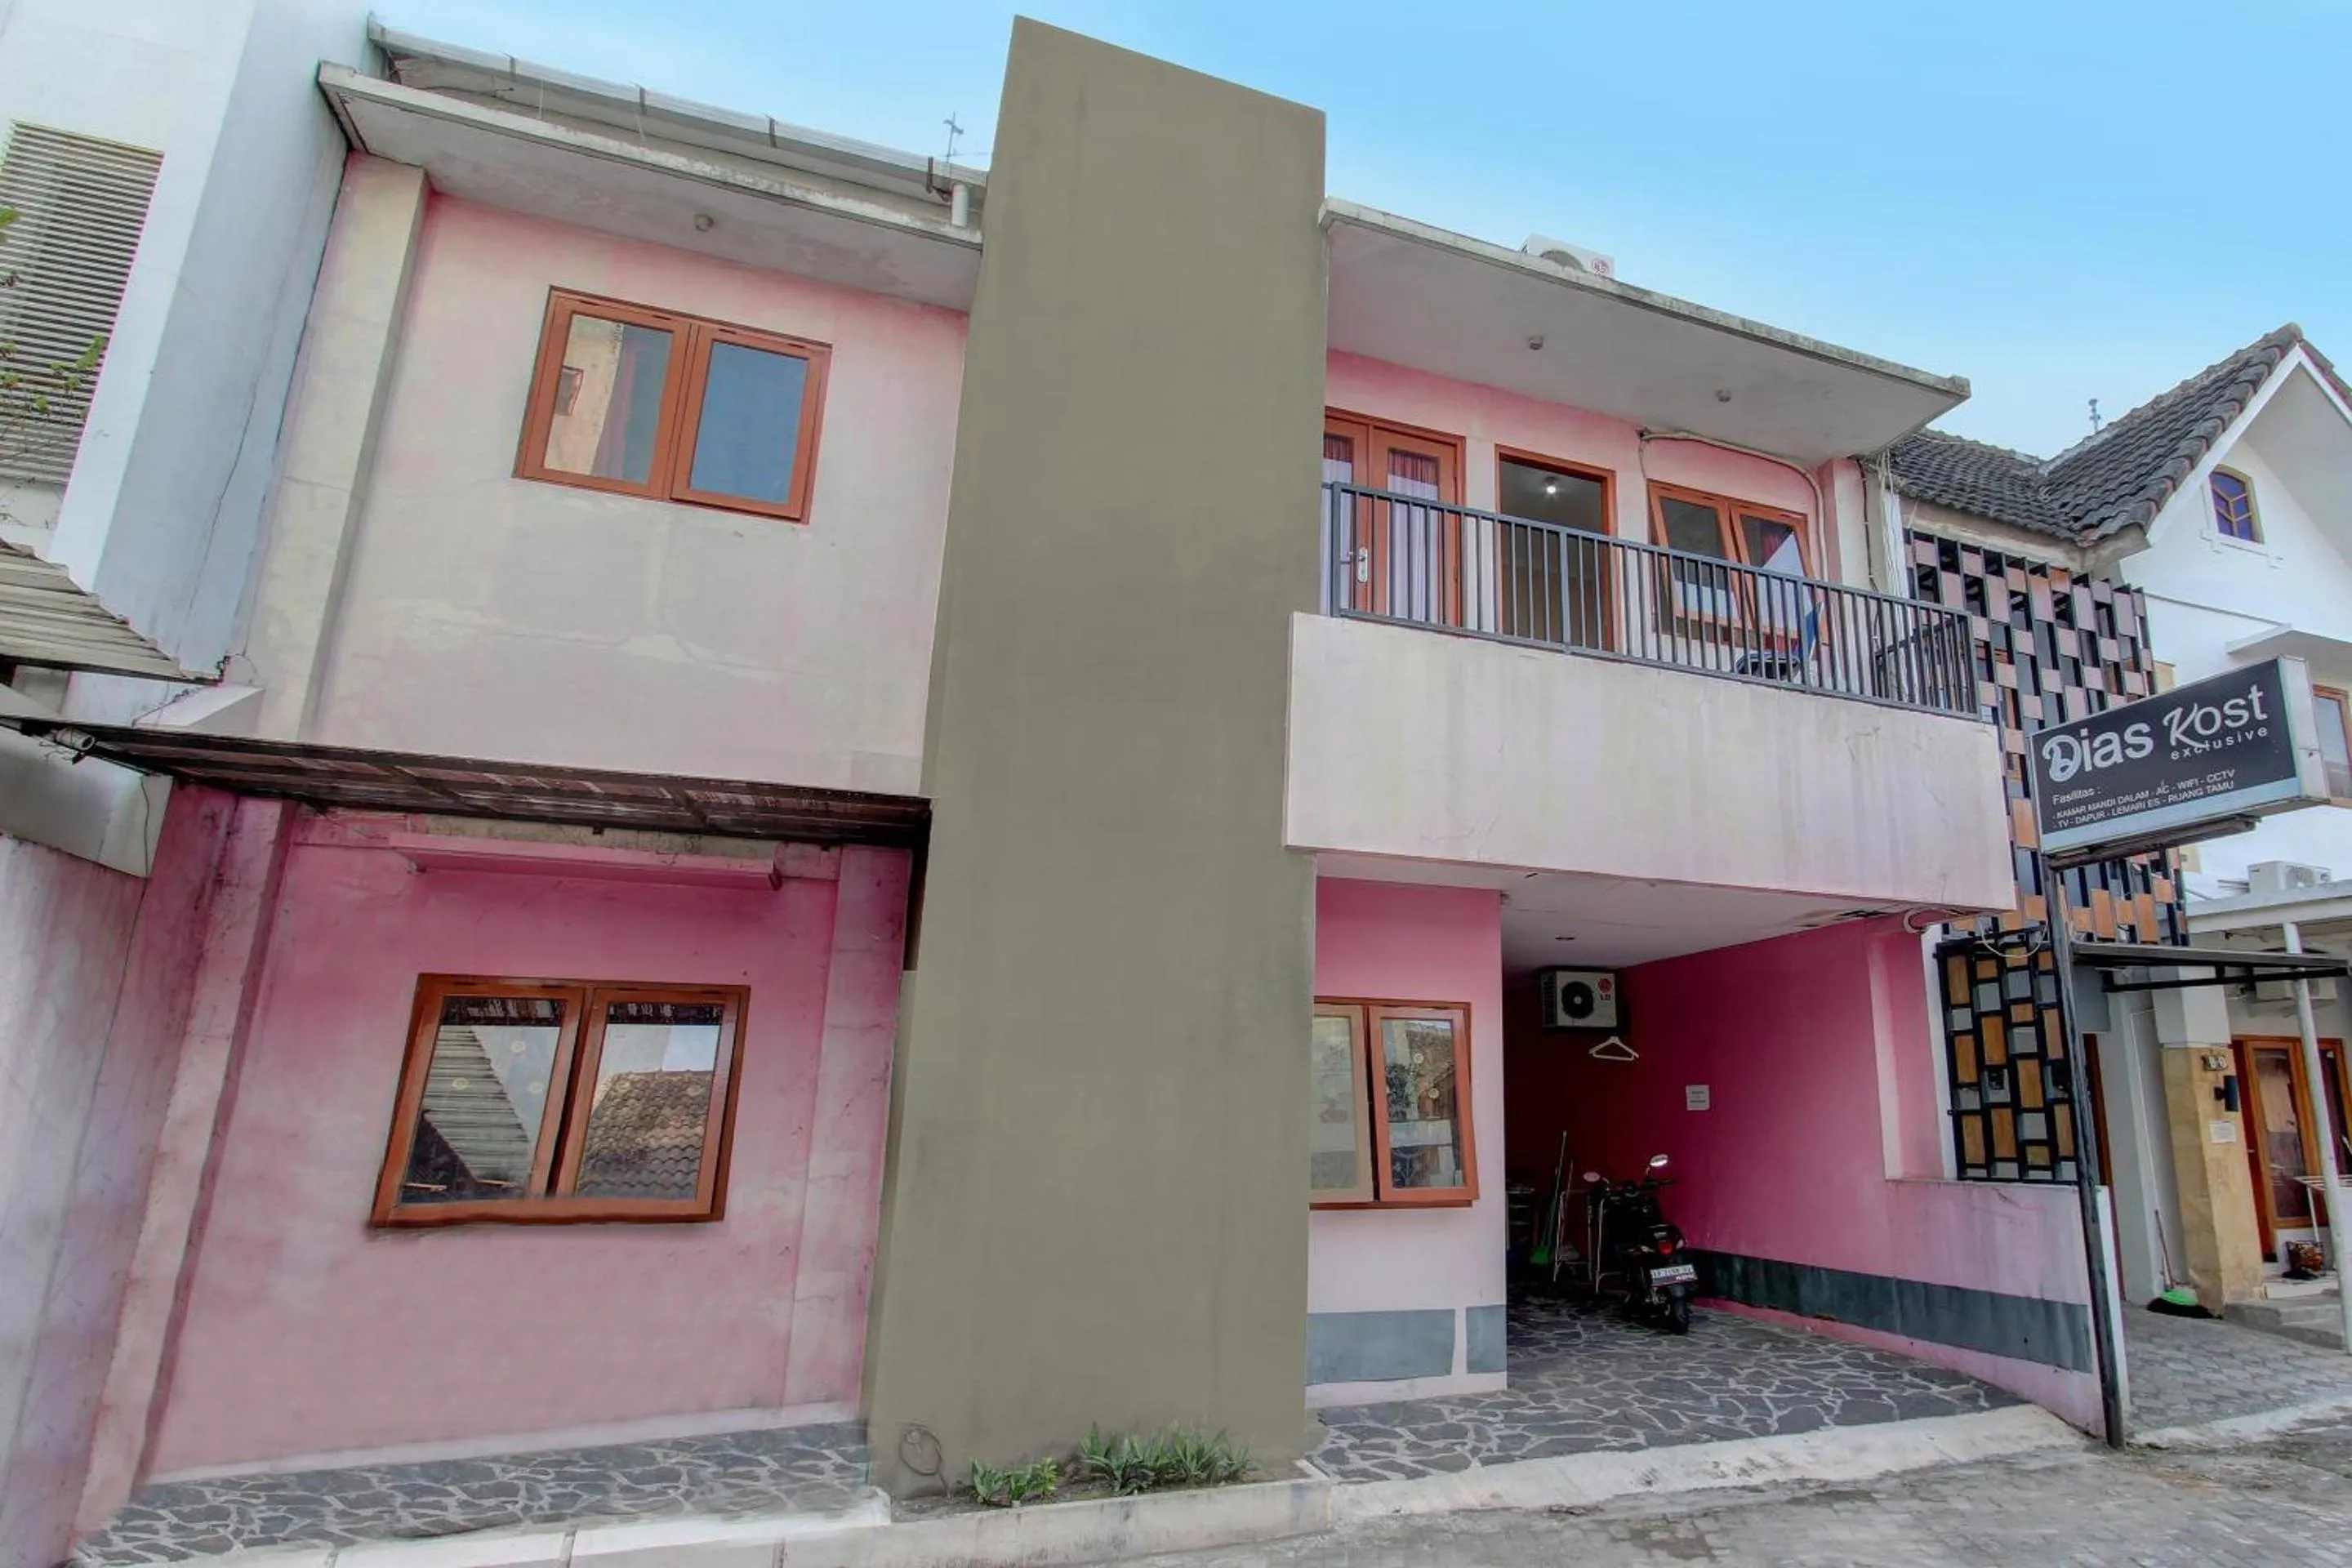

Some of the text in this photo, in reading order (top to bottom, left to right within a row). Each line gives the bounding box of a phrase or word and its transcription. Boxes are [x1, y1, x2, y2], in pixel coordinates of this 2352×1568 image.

[2042, 684, 2268, 782] Dias Kost
[2171, 727, 2268, 760] exclusive
[2056, 805, 2087, 818] KAMAR
[2087, 800, 2116, 812] MANDI
[2117, 790, 2149, 804] DALAM
[2177, 777, 2200, 789] WIFI
[2206, 768, 2235, 783] CCTV
[2059, 819, 2069, 828] TV
[2075, 811, 2105, 824] DAPUR
[2111, 800, 2146, 816] LEMARI
[2168, 788, 2204, 803] RUANG
[2205, 780, 2234, 794] TAMU
